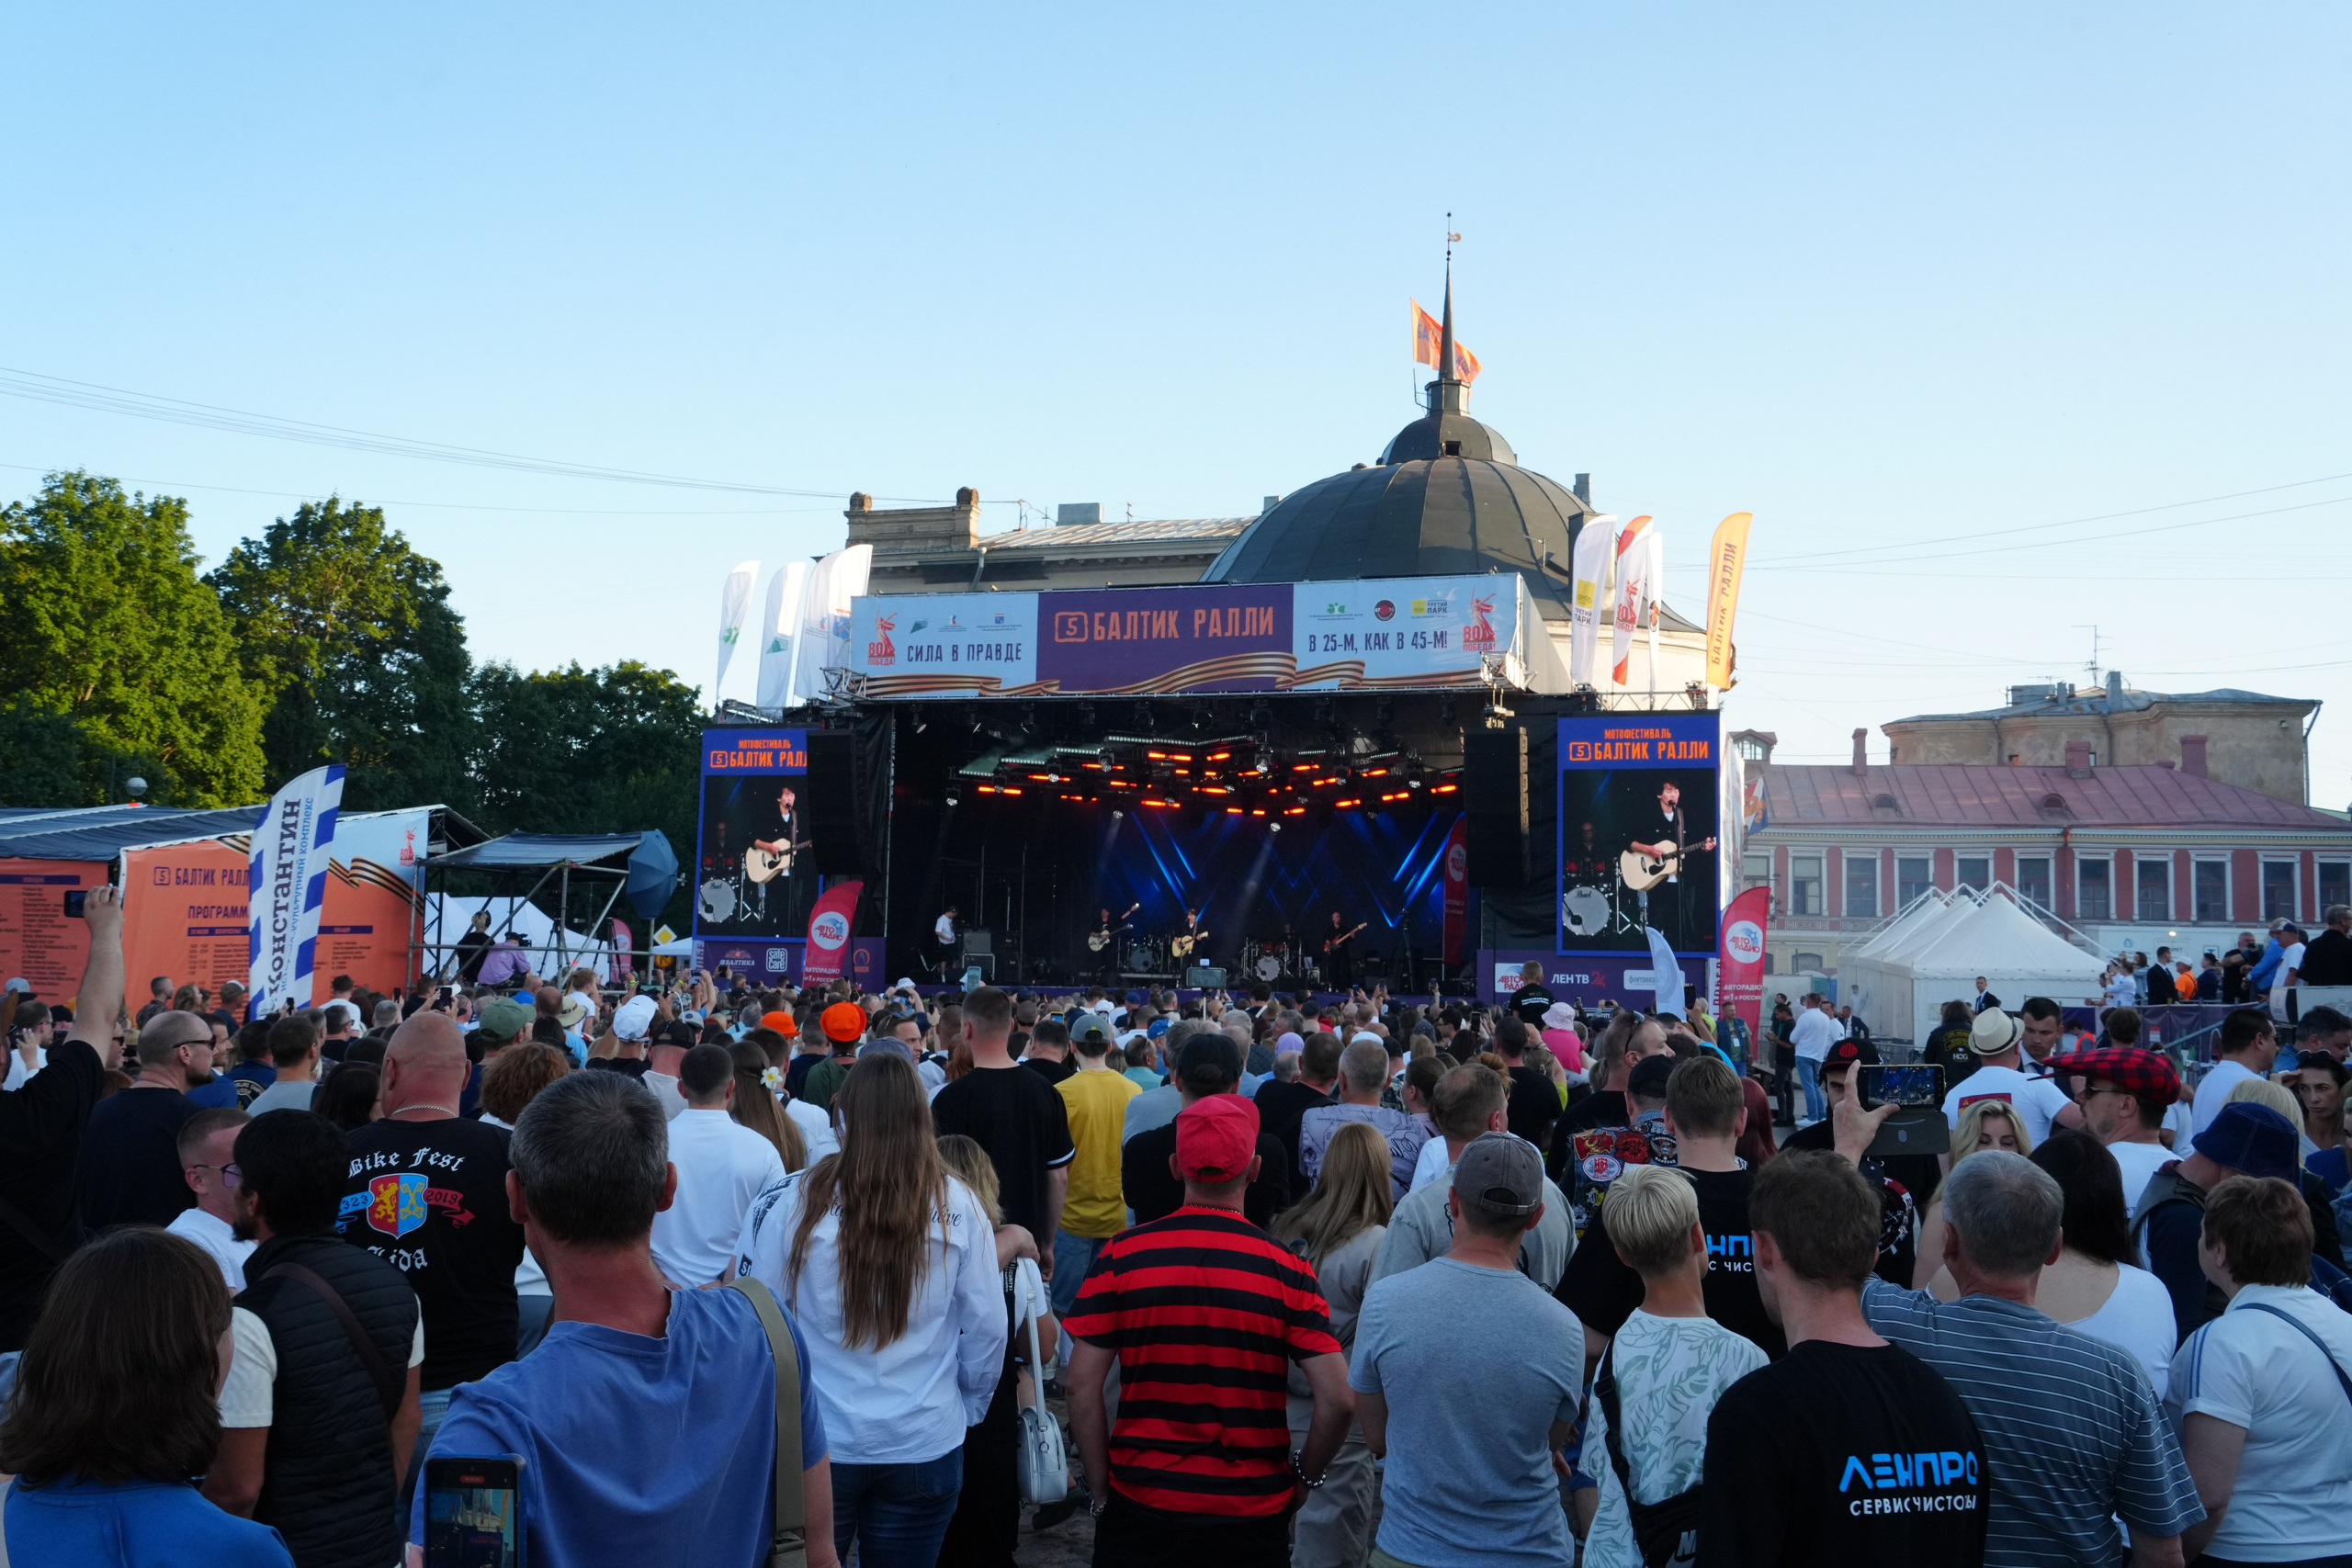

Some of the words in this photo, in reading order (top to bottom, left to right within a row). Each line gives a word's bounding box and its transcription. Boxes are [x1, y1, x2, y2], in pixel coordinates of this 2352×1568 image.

[1066, 617, 1078, 636] 5
[1093, 610, 1179, 641] БАЛТИК
[1194, 606, 1273, 637] РАЛЛИ
[1463, 626, 1480, 641] 80
[1309, 634, 1316, 652] В
[1323, 633, 1358, 654] 25-М,
[1364, 632, 1389, 650] КАК
[1396, 632, 1404, 650] В
[1411, 630, 1447, 649] 45-М!
[1463, 642, 1496, 651] ПОБЕДА!
[868, 642, 884, 657] 80
[908, 645, 943, 662] СИЛА
[952, 645, 959, 661] В
[967, 643, 1022, 662] ПРАВДЕ
[867, 657, 896, 666] ПОБЕДА!
[1604, 728, 1671, 739] МОТОФЕСТИВАЛЬ
[739, 739, 791, 749] МОТОФЕСТИВАЛЬ
[1577, 745, 1584, 757] 5
[1594, 742, 1649, 760] БАЛТИК
[1658, 741, 1708, 759] РАЛЛИ
[716, 753, 723, 764] 5
[729, 751, 774, 767] БАЛТИК
[175, 868, 216, 886] БАЛТИК
[221, 869, 250, 886] РАЛЛ
[188, 906, 250, 919] ПРОГРАММ
[815, 925, 835, 933] АВТО
[819, 931, 843, 941] РАДИО
[1729, 936, 1750, 945] АВТО
[769, 948, 786, 959] safe
[1735, 944, 1760, 953] РАДИО
[348, 1150, 400, 1179] Bike
[408, 1147, 466, 1172] Fest
[425, 1190, 458, 1205] 2019
[1724, 1261, 1752, 1272] ЧИС
